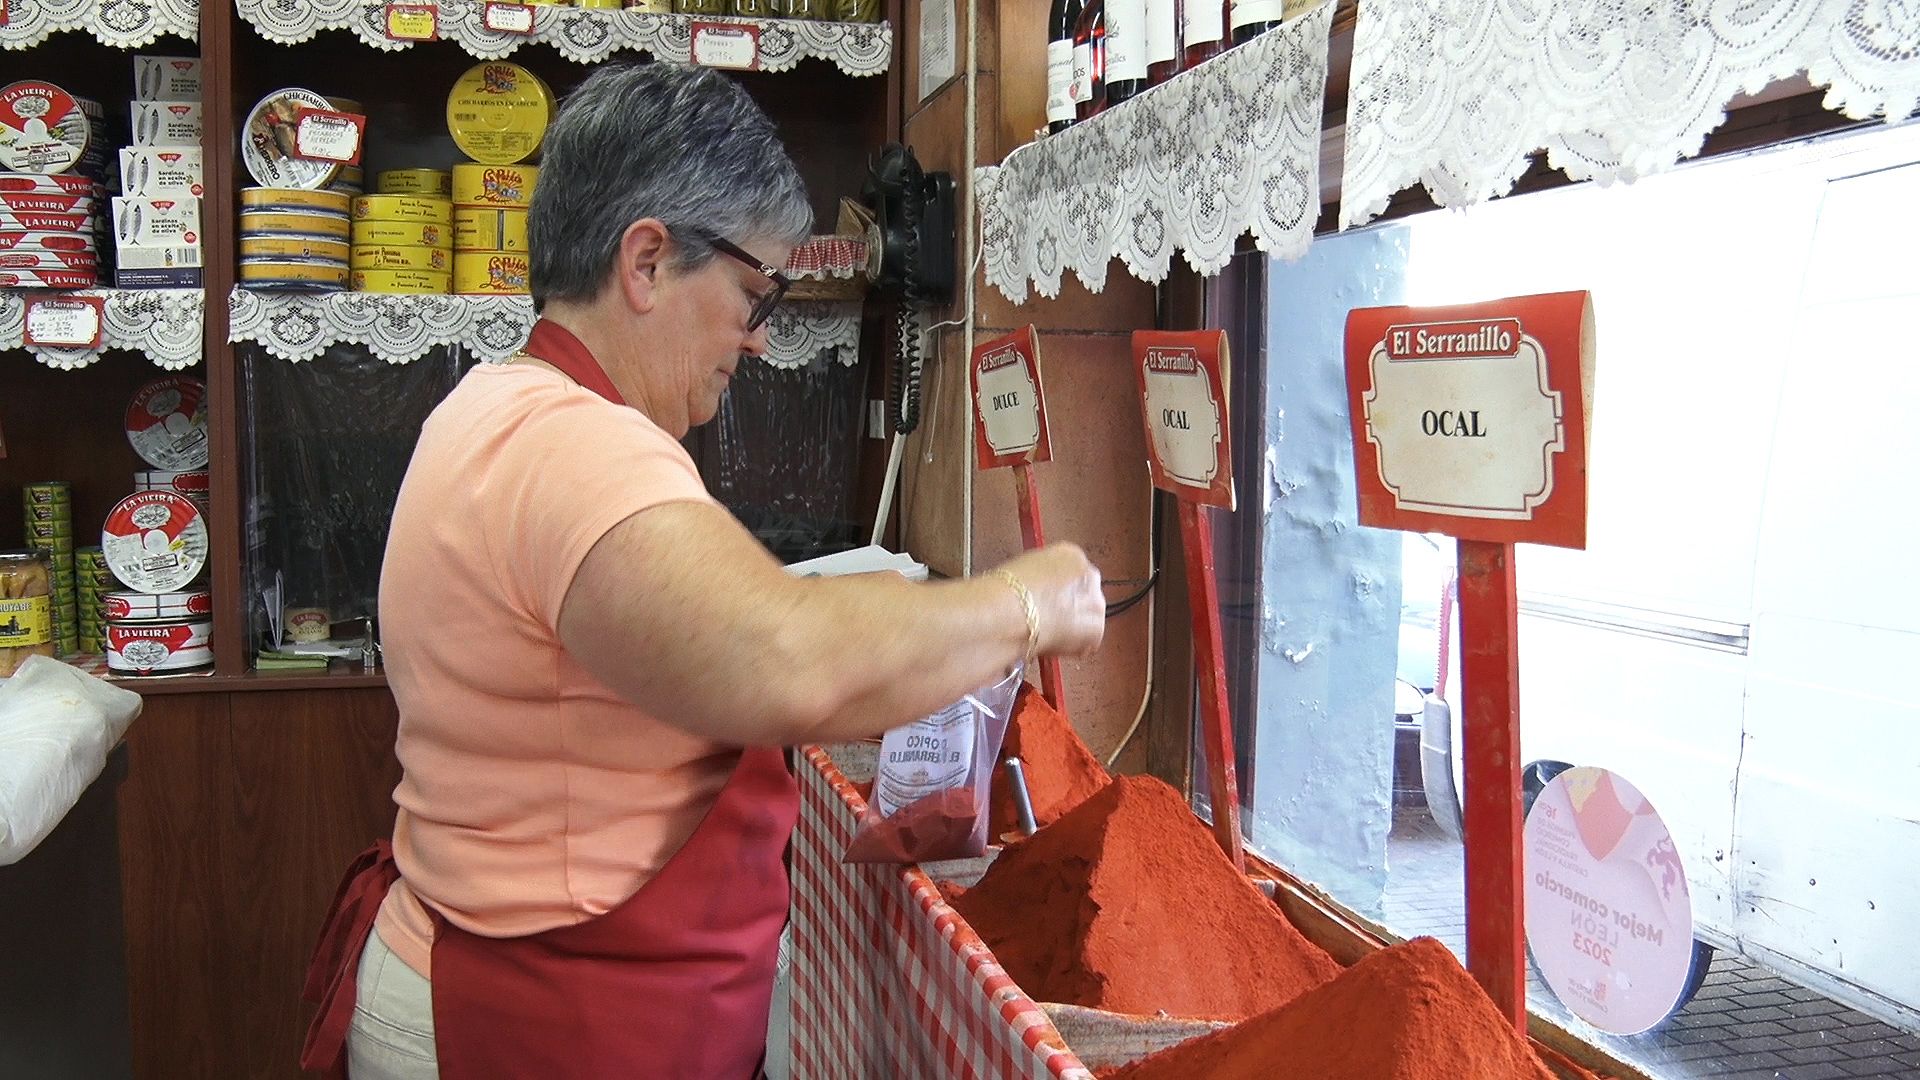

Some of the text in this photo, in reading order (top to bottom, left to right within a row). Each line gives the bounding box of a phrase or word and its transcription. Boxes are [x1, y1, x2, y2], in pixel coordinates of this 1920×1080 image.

[12, 200, 65, 211] LA VIEIRA
[41, 219, 76, 228] VIEIRA
[47, 276, 91, 285] LA VIEIRA
[1392, 325, 1511, 355] El Serranillo
[982, 347, 1016, 371] El Serranillo
[1149, 351, 1194, 371] El Serranillo
[992, 391, 1020, 411] DULCE
[1162, 408, 1190, 430] OCAL
[1421, 410, 1487, 437] OCAL
